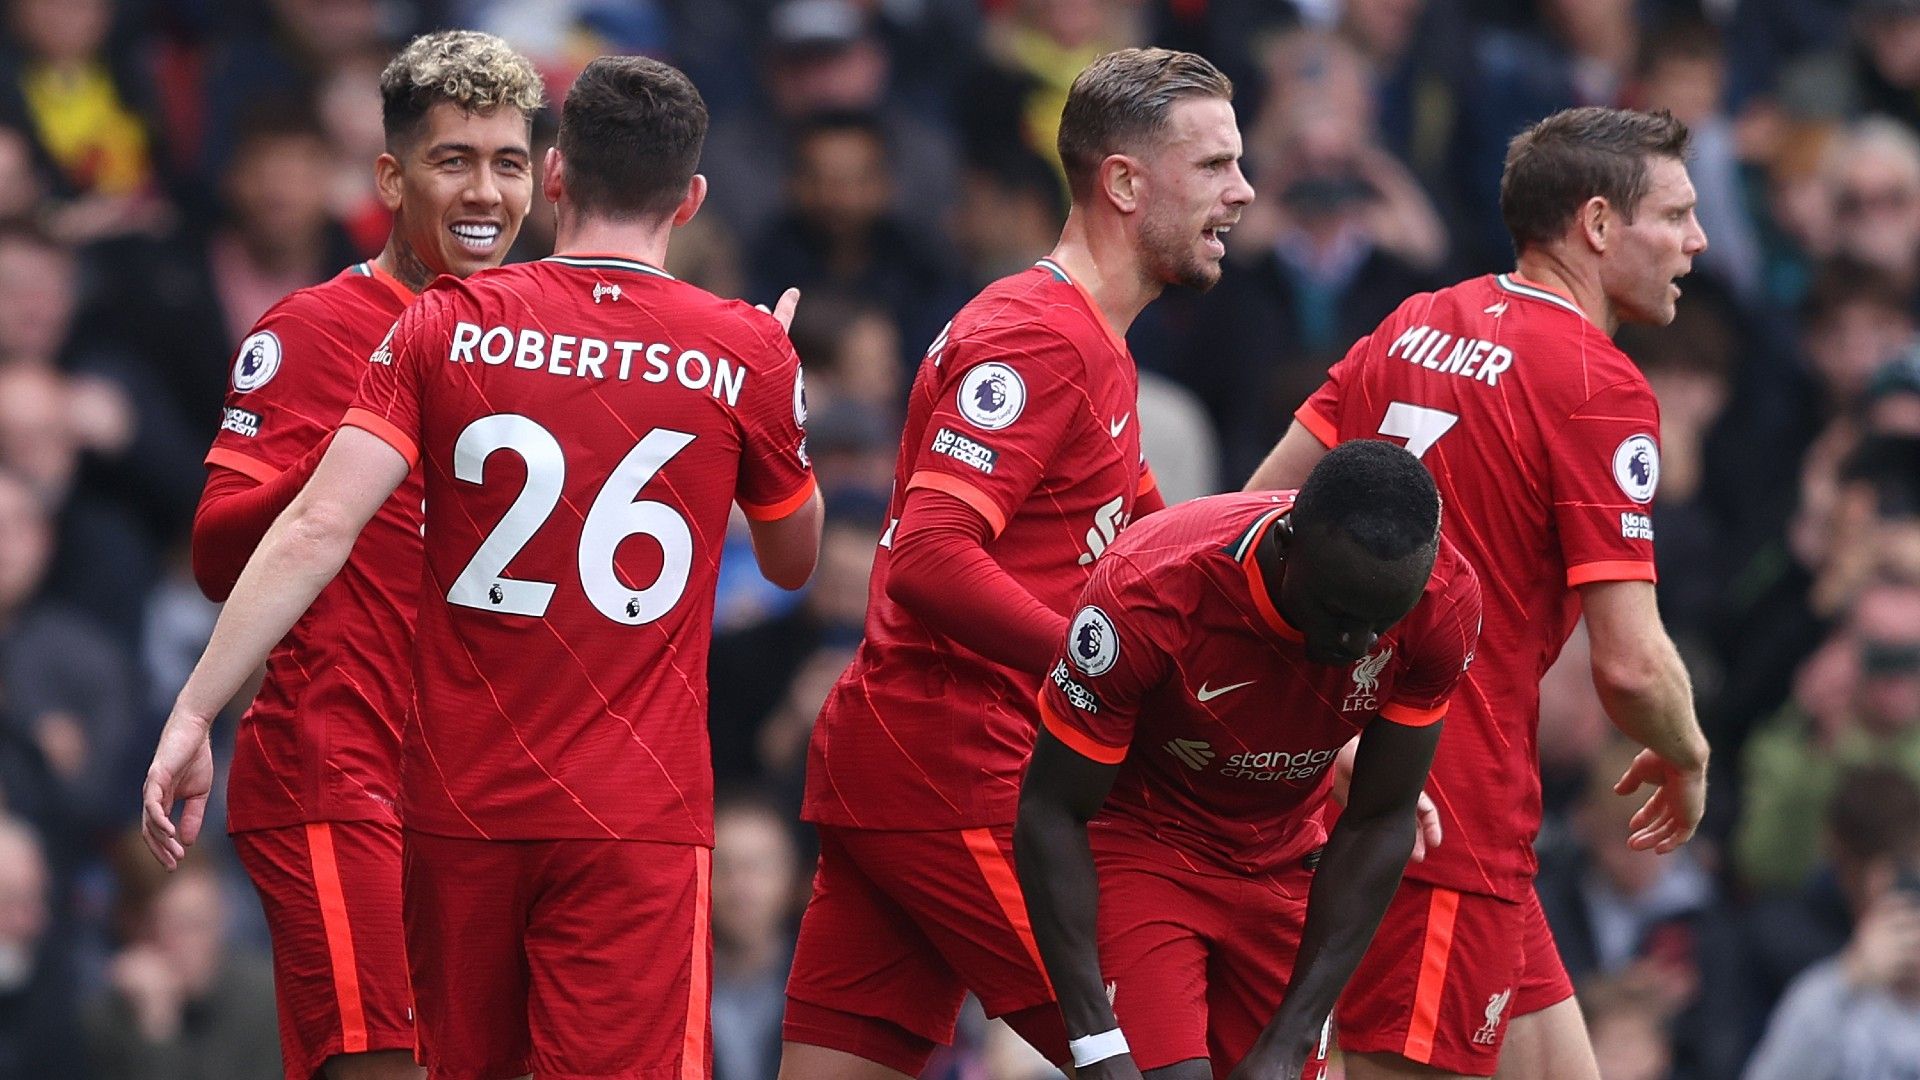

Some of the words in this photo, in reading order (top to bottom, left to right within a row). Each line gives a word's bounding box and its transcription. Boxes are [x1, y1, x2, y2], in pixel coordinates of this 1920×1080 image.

[449, 321, 746, 407] ROBERTSON
[1387, 325, 1513, 386] MILNER
[936, 428, 956, 444] No
[954, 436, 992, 462] room
[931, 442, 951, 453] for
[948, 446, 993, 474] racism
[446, 413, 698, 625] 26
[1621, 512, 1639, 528] No
[1622, 526, 1639, 538] for
[1051, 670, 1065, 686] for
[1055, 658, 1069, 678] No
[1226, 747, 1341, 768] standar
[1220, 762, 1328, 781] charter
